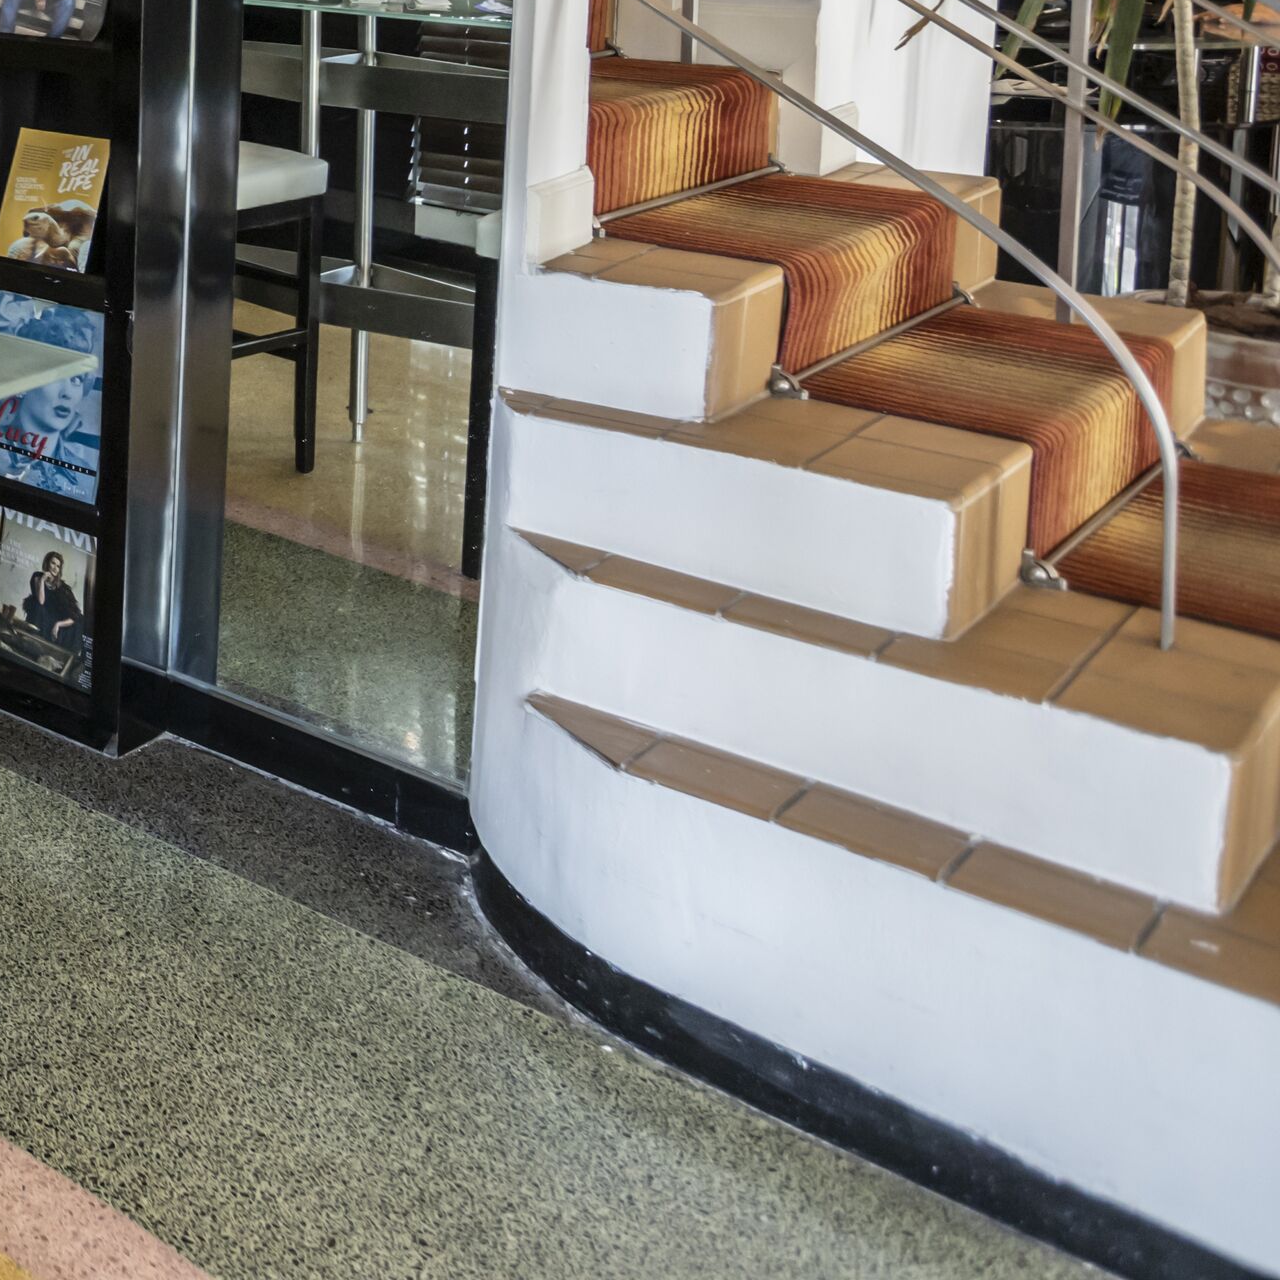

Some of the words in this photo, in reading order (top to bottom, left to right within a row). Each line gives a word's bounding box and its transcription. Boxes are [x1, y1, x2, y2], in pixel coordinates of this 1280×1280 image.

[71, 144, 94, 162] IN
[59, 158, 100, 178] REAL
[57, 173, 96, 194] LIFE
